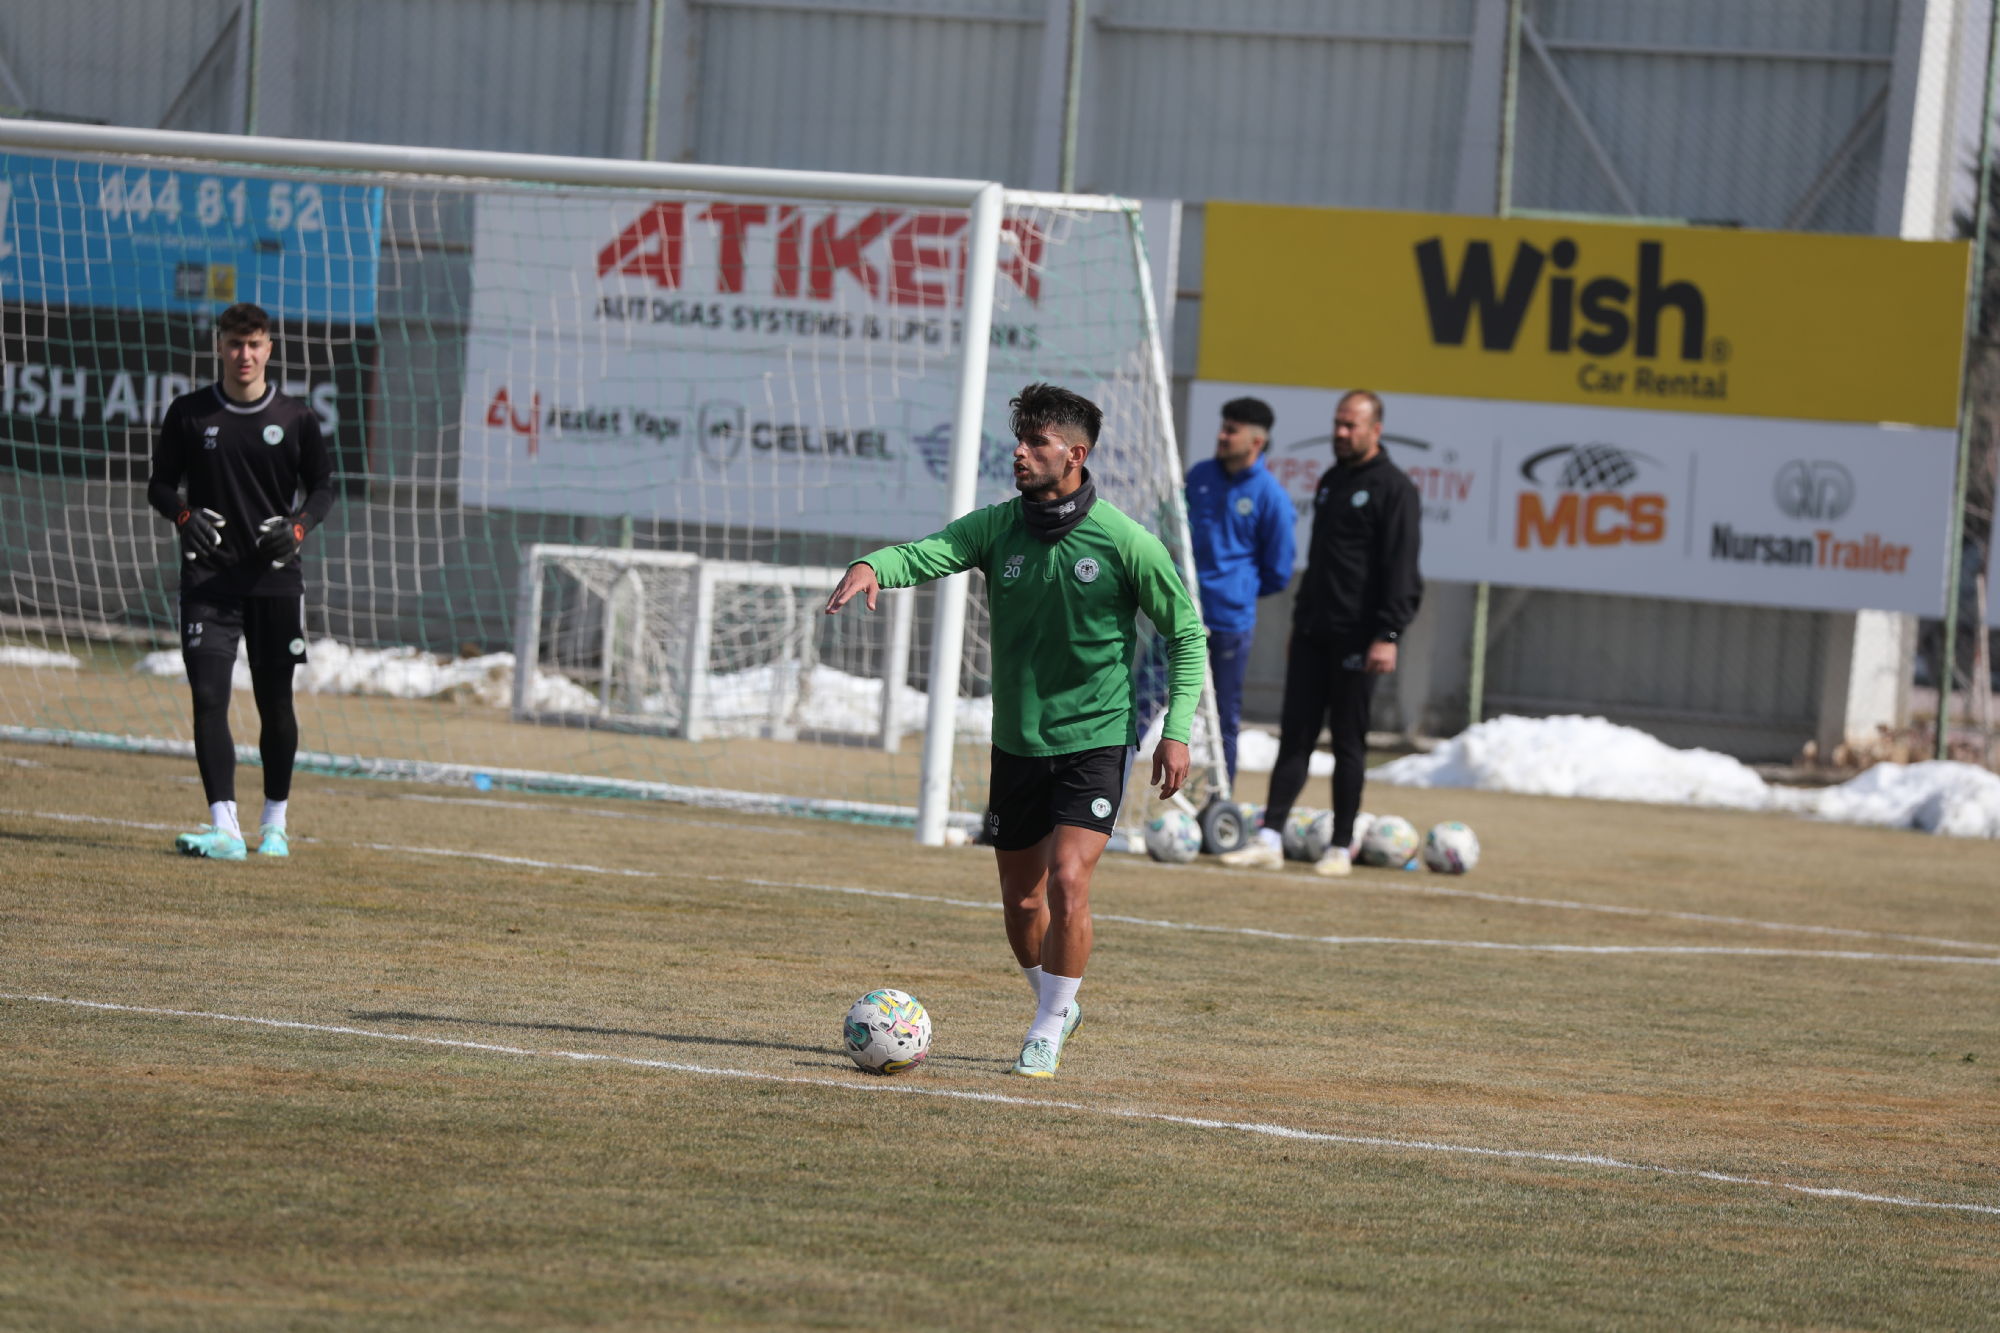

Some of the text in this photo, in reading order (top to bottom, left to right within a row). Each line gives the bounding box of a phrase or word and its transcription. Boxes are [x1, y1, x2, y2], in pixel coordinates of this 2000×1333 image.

[98, 172, 322, 232] 444 81 52
[594, 297, 722, 330] AUTOGAS
[731, 305, 851, 338] SYSTEMS
[1414, 236, 1708, 361] Wish
[1576, 364, 1728, 399] Car Rental
[204, 438, 217, 449] 25
[1515, 492, 1668, 551] MCS
[1711, 522, 1912, 574] NursanTrailer
[1004, 566, 1021, 578] 20
